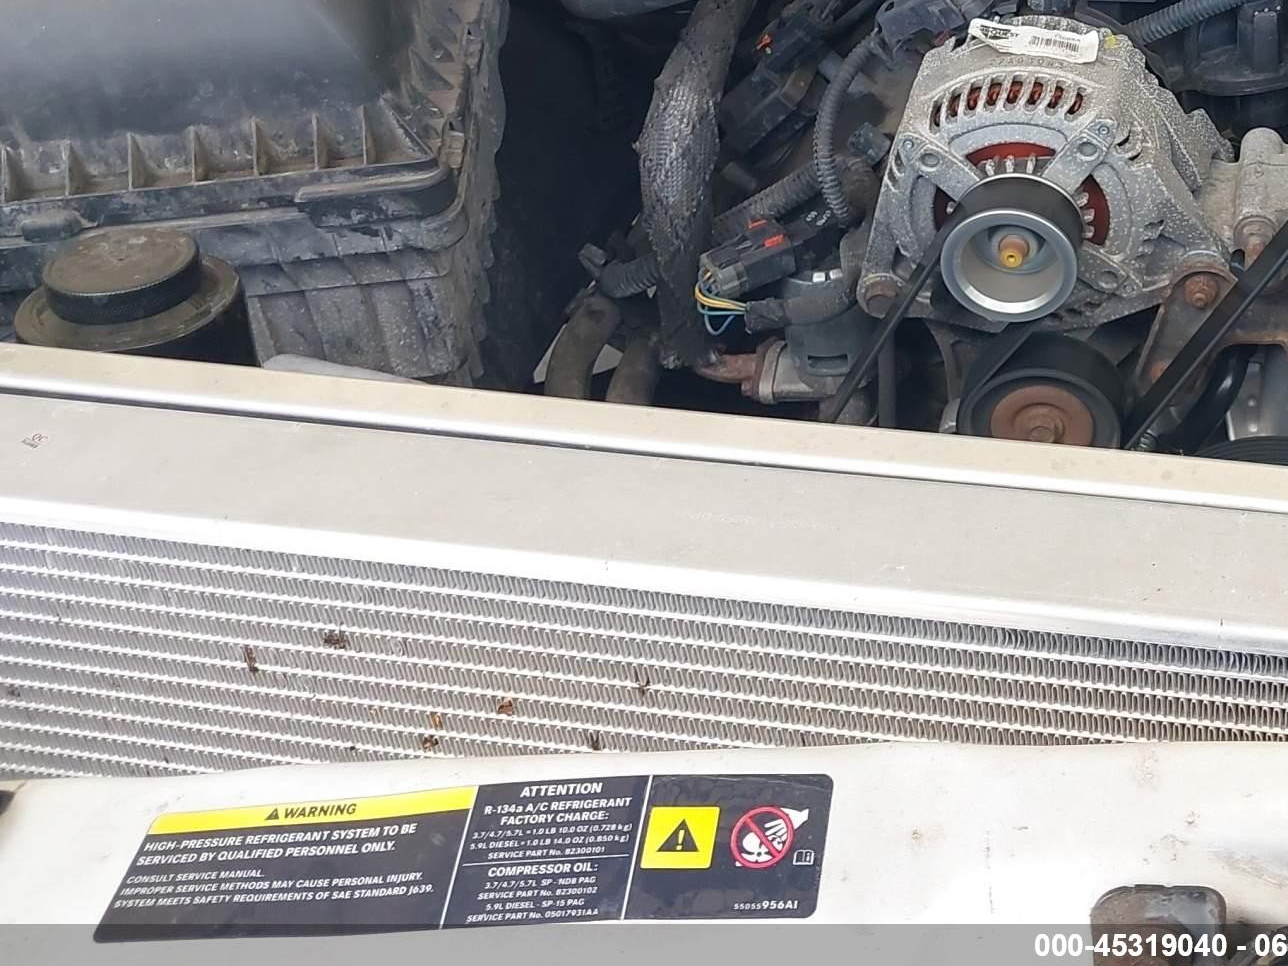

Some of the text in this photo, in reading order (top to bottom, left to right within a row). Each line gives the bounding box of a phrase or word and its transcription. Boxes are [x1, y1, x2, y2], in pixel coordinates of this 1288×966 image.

[520, 782, 603, 798] ATTENTION
[284, 803, 357, 819] WARNING
[484, 797, 632, 815] R-134a A/C REFRIGERANT
[500, 810, 609, 826] FACTORY CHARGE:
[144, 823, 418, 851] HIGH-PRESSURE REFRIGERANT SYSTEM TO BE
[489, 840, 519, 849] DIESEL
[136, 841, 396, 866] SERVICED BY QUALIFIED PERSONNEL ONLY.
[487, 850, 525, 859] SERVICE
[525, 849, 548, 857] PART
[126, 869, 265, 884] CONSULT SERVICE MANUAL.
[488, 862, 599, 877] COMPRESSOR OIL:
[120, 872, 423, 896] IMPROPER SERVICE METHODS MAY CAUSE PERSONAL INJURY.
[578, 876, 596, 884] PAG
[113, 884, 434, 908] SYSTEM MEETS SAFETY REQUIREMENTS OF SAE STANDARD J639.
[477, 891, 514, 900] SERVICE
[516, 890, 539, 898] PART
[485, 903, 503, 911] 5.9L
[505, 901, 535, 910] DIESEL
[566, 898, 585, 906] PAG
[466, 913, 504, 922] SERVICE
[504, 911, 528, 920] PART
